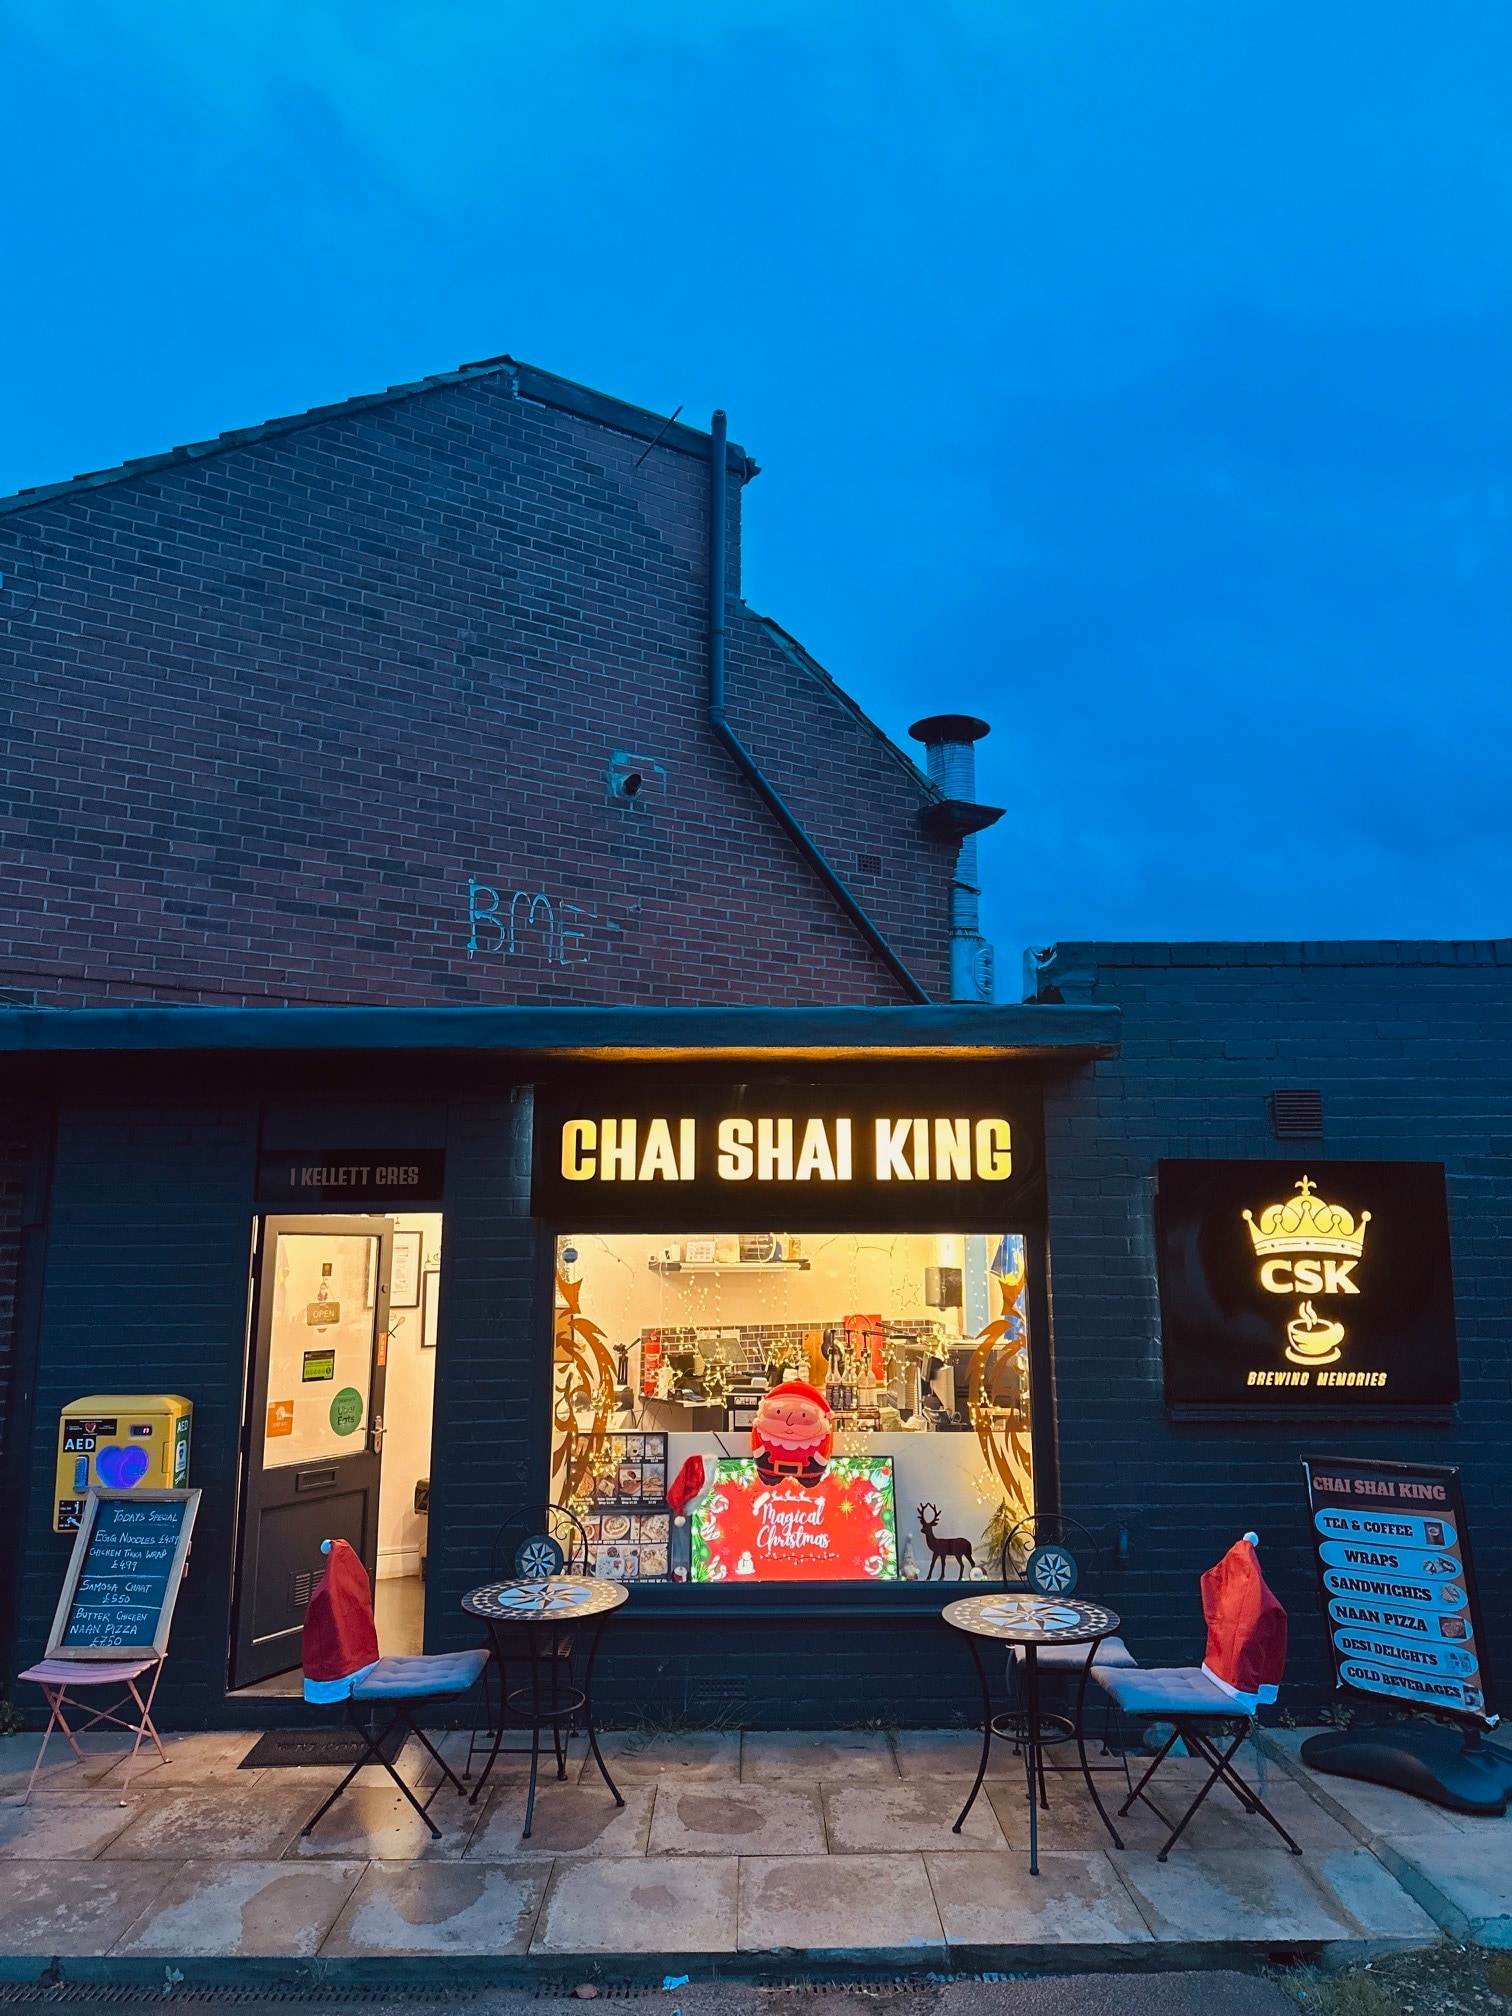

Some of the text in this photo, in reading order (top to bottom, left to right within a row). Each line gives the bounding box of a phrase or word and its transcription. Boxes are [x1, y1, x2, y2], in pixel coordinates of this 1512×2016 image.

[561, 1118, 1013, 1181] CHAI SHAI KING
[300, 1167, 370, 1187] KELLETT
[375, 1166, 419, 1186] CRES
[1260, 1259, 1360, 1294] CSK
[312, 1310, 335, 1318] OPEN
[1247, 1371, 1387, 1387] BREWING MEMORIES
[337, 1405, 356, 1415] Uber
[177, 1420, 188, 1433] AED
[337, 1416, 355, 1426] Eats
[65, 1438, 95, 1450] AED
[1313, 1476, 1446, 1501] CHAI SHAI KING
[148, 1510, 178, 1522] SPECIAL
[761, 1503, 825, 1536] Magical
[1323, 1517, 1414, 1537] TEA & COFFEE
[94, 1529, 117, 1542] EGG
[119, 1532, 156, 1544] NOODLES
[756, 1525, 831, 1551] Christmas
[89, 1547, 167, 1560] CHICKEN TIKKA WRAP
[1344, 1549, 1399, 1568] WRAPS
[79, 1580, 118, 1592] SAMOSA
[1330, 1576, 1432, 1602] SANDWICHES
[76, 1608, 148, 1622] BUTTER CHICKEN
[1335, 1605, 1428, 1632] NAAN PIZZA
[70, 1624, 138, 1634] NAAN PIZZA
[1342, 1638, 1438, 1666] DESI DELIGHTS
[1346, 1666, 1461, 1699] COLD BEVERAGES
